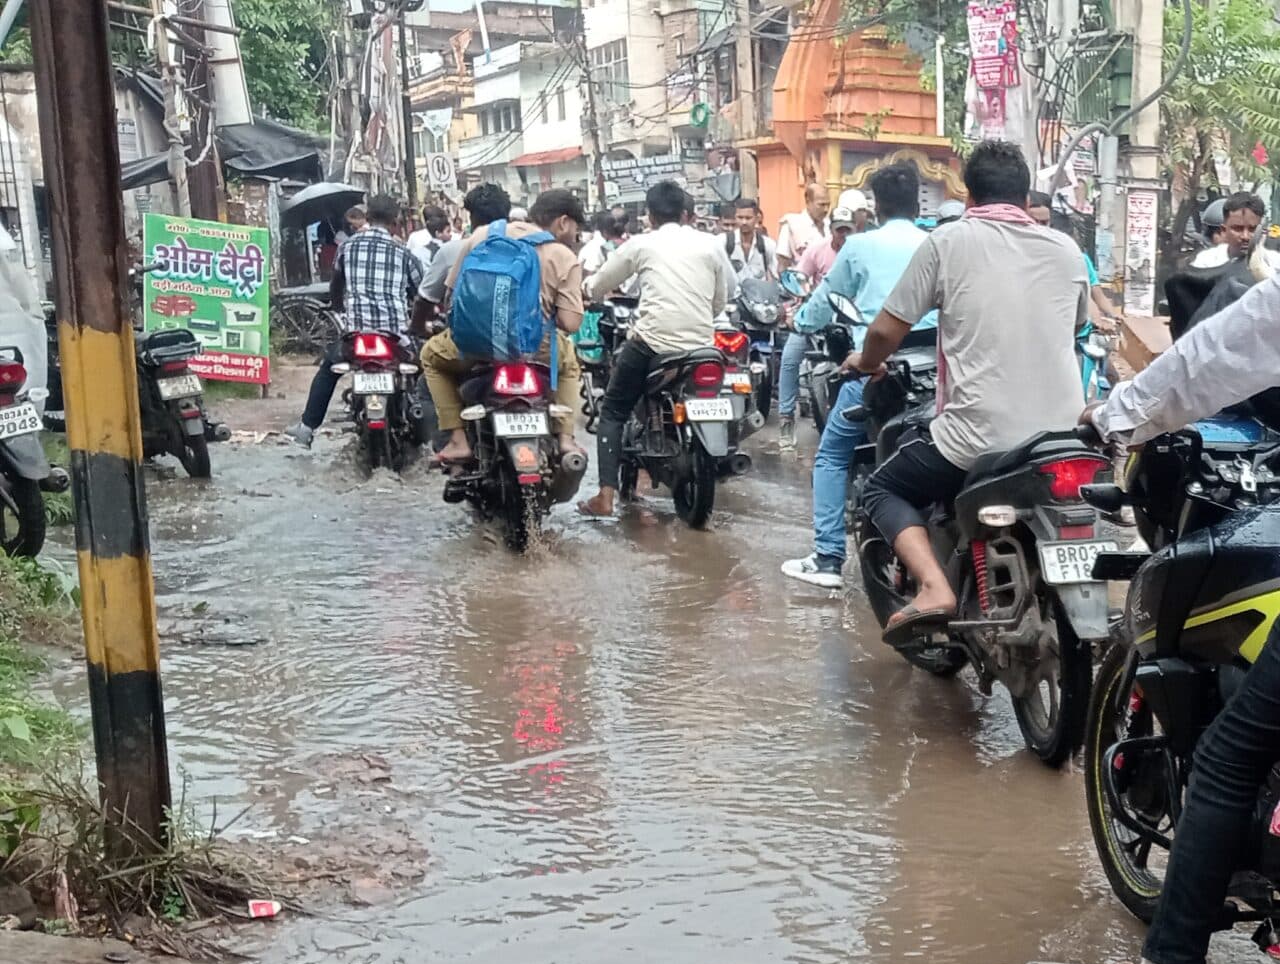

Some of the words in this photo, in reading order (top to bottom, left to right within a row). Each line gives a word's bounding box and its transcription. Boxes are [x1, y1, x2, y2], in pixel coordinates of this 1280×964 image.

[153, 236, 213, 279] ओम
[1056, 545, 1105, 564] BR03
[1060, 563, 1092, 580] F18
